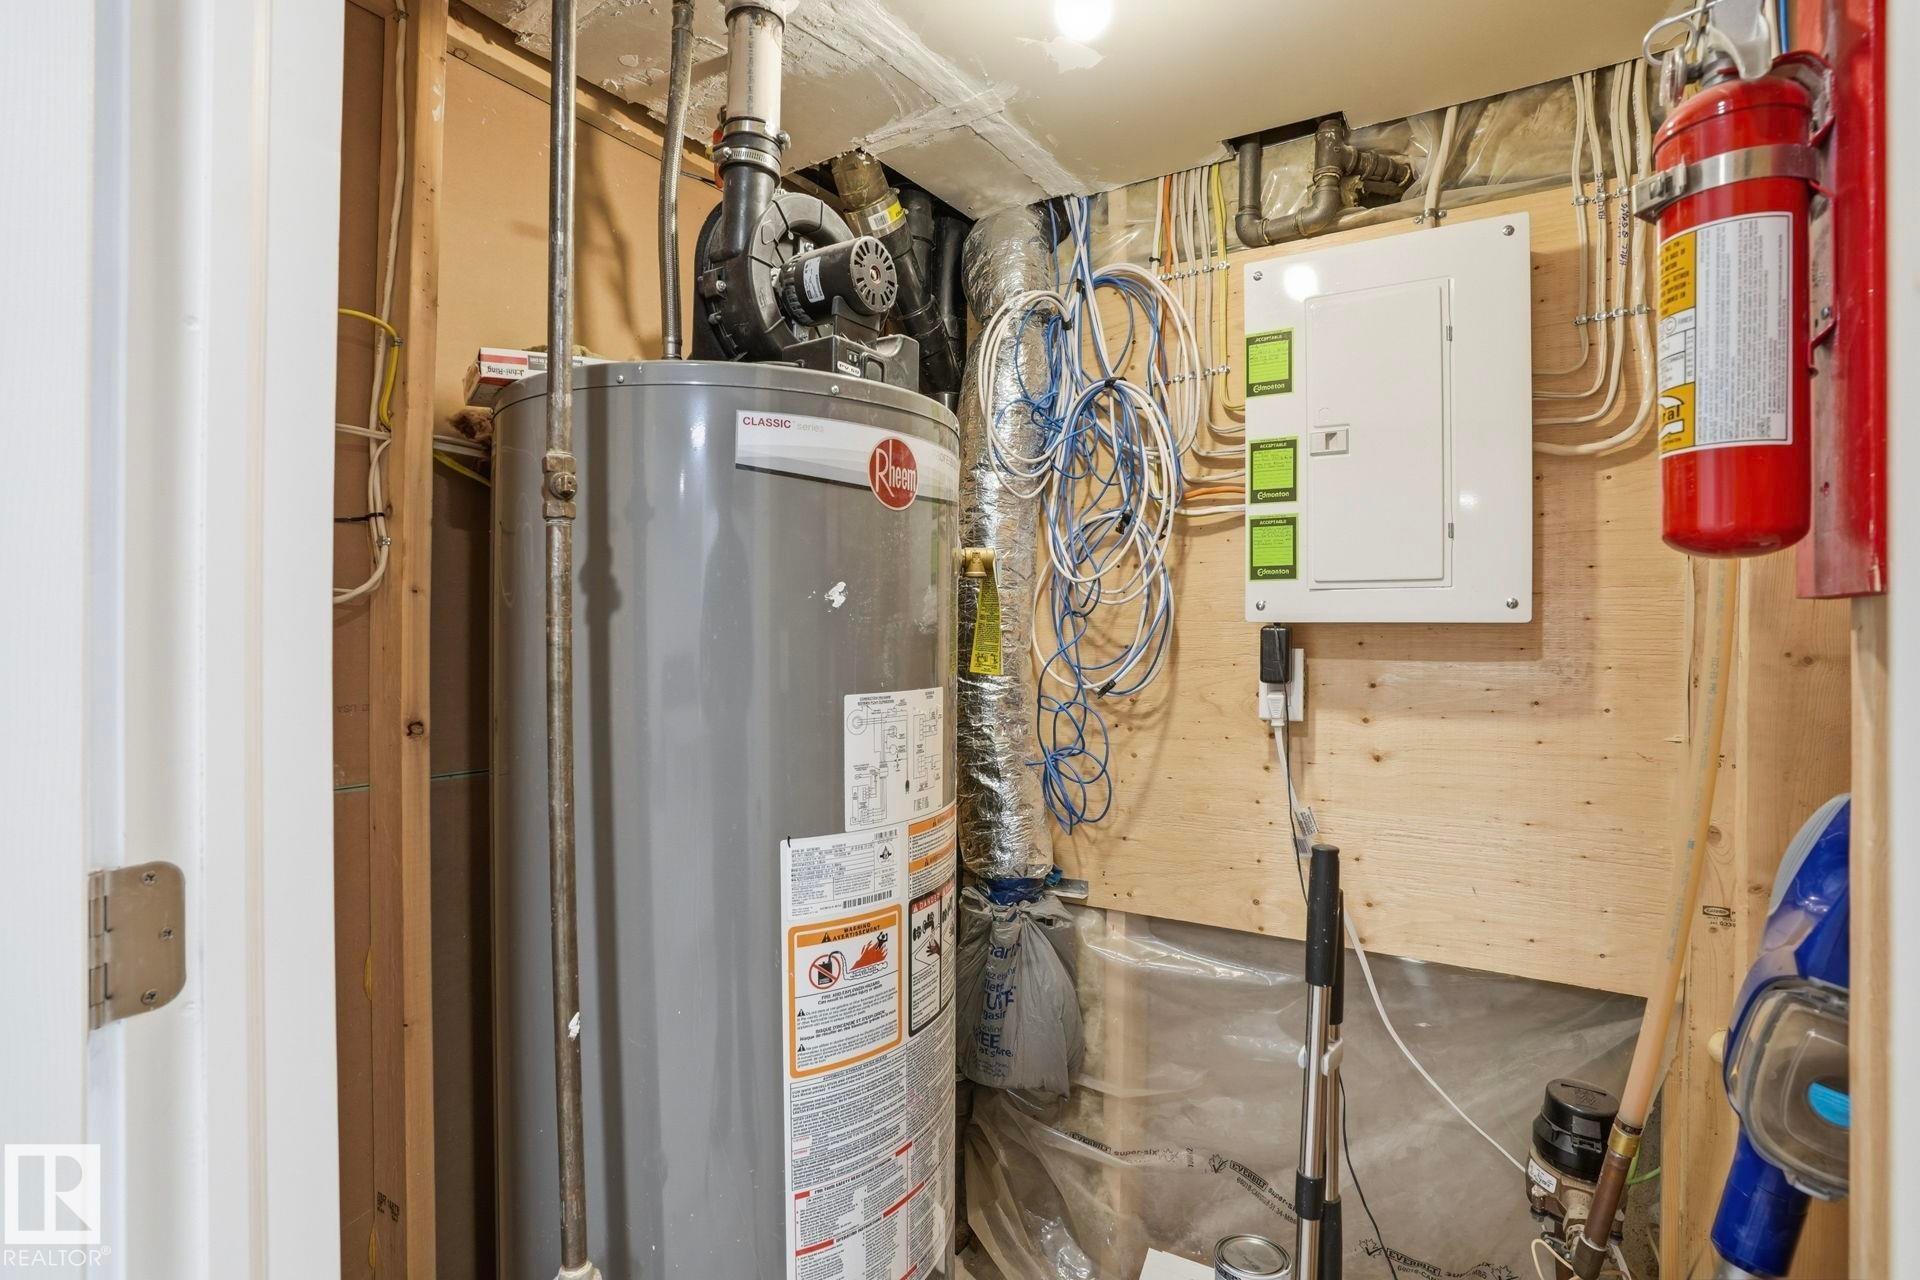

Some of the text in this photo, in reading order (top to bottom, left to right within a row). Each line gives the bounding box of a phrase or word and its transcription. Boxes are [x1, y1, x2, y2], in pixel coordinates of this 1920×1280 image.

[1253, 383, 1285, 393] Edmonton
[742, 416, 824, 433] CLASSIC series
[875, 439, 916, 498] Rheem
[1257, 491, 1290, 500] Edmonton
[1257, 568, 1290, 577] Edmonton
[832, 925, 881, 941] AVERTISSEMENT
[844, 922, 871, 933] WARNING
[1231, 1161, 1296, 1212] EVERBILT super-si
[1388, 1249, 1440, 1276] EVERBILT
